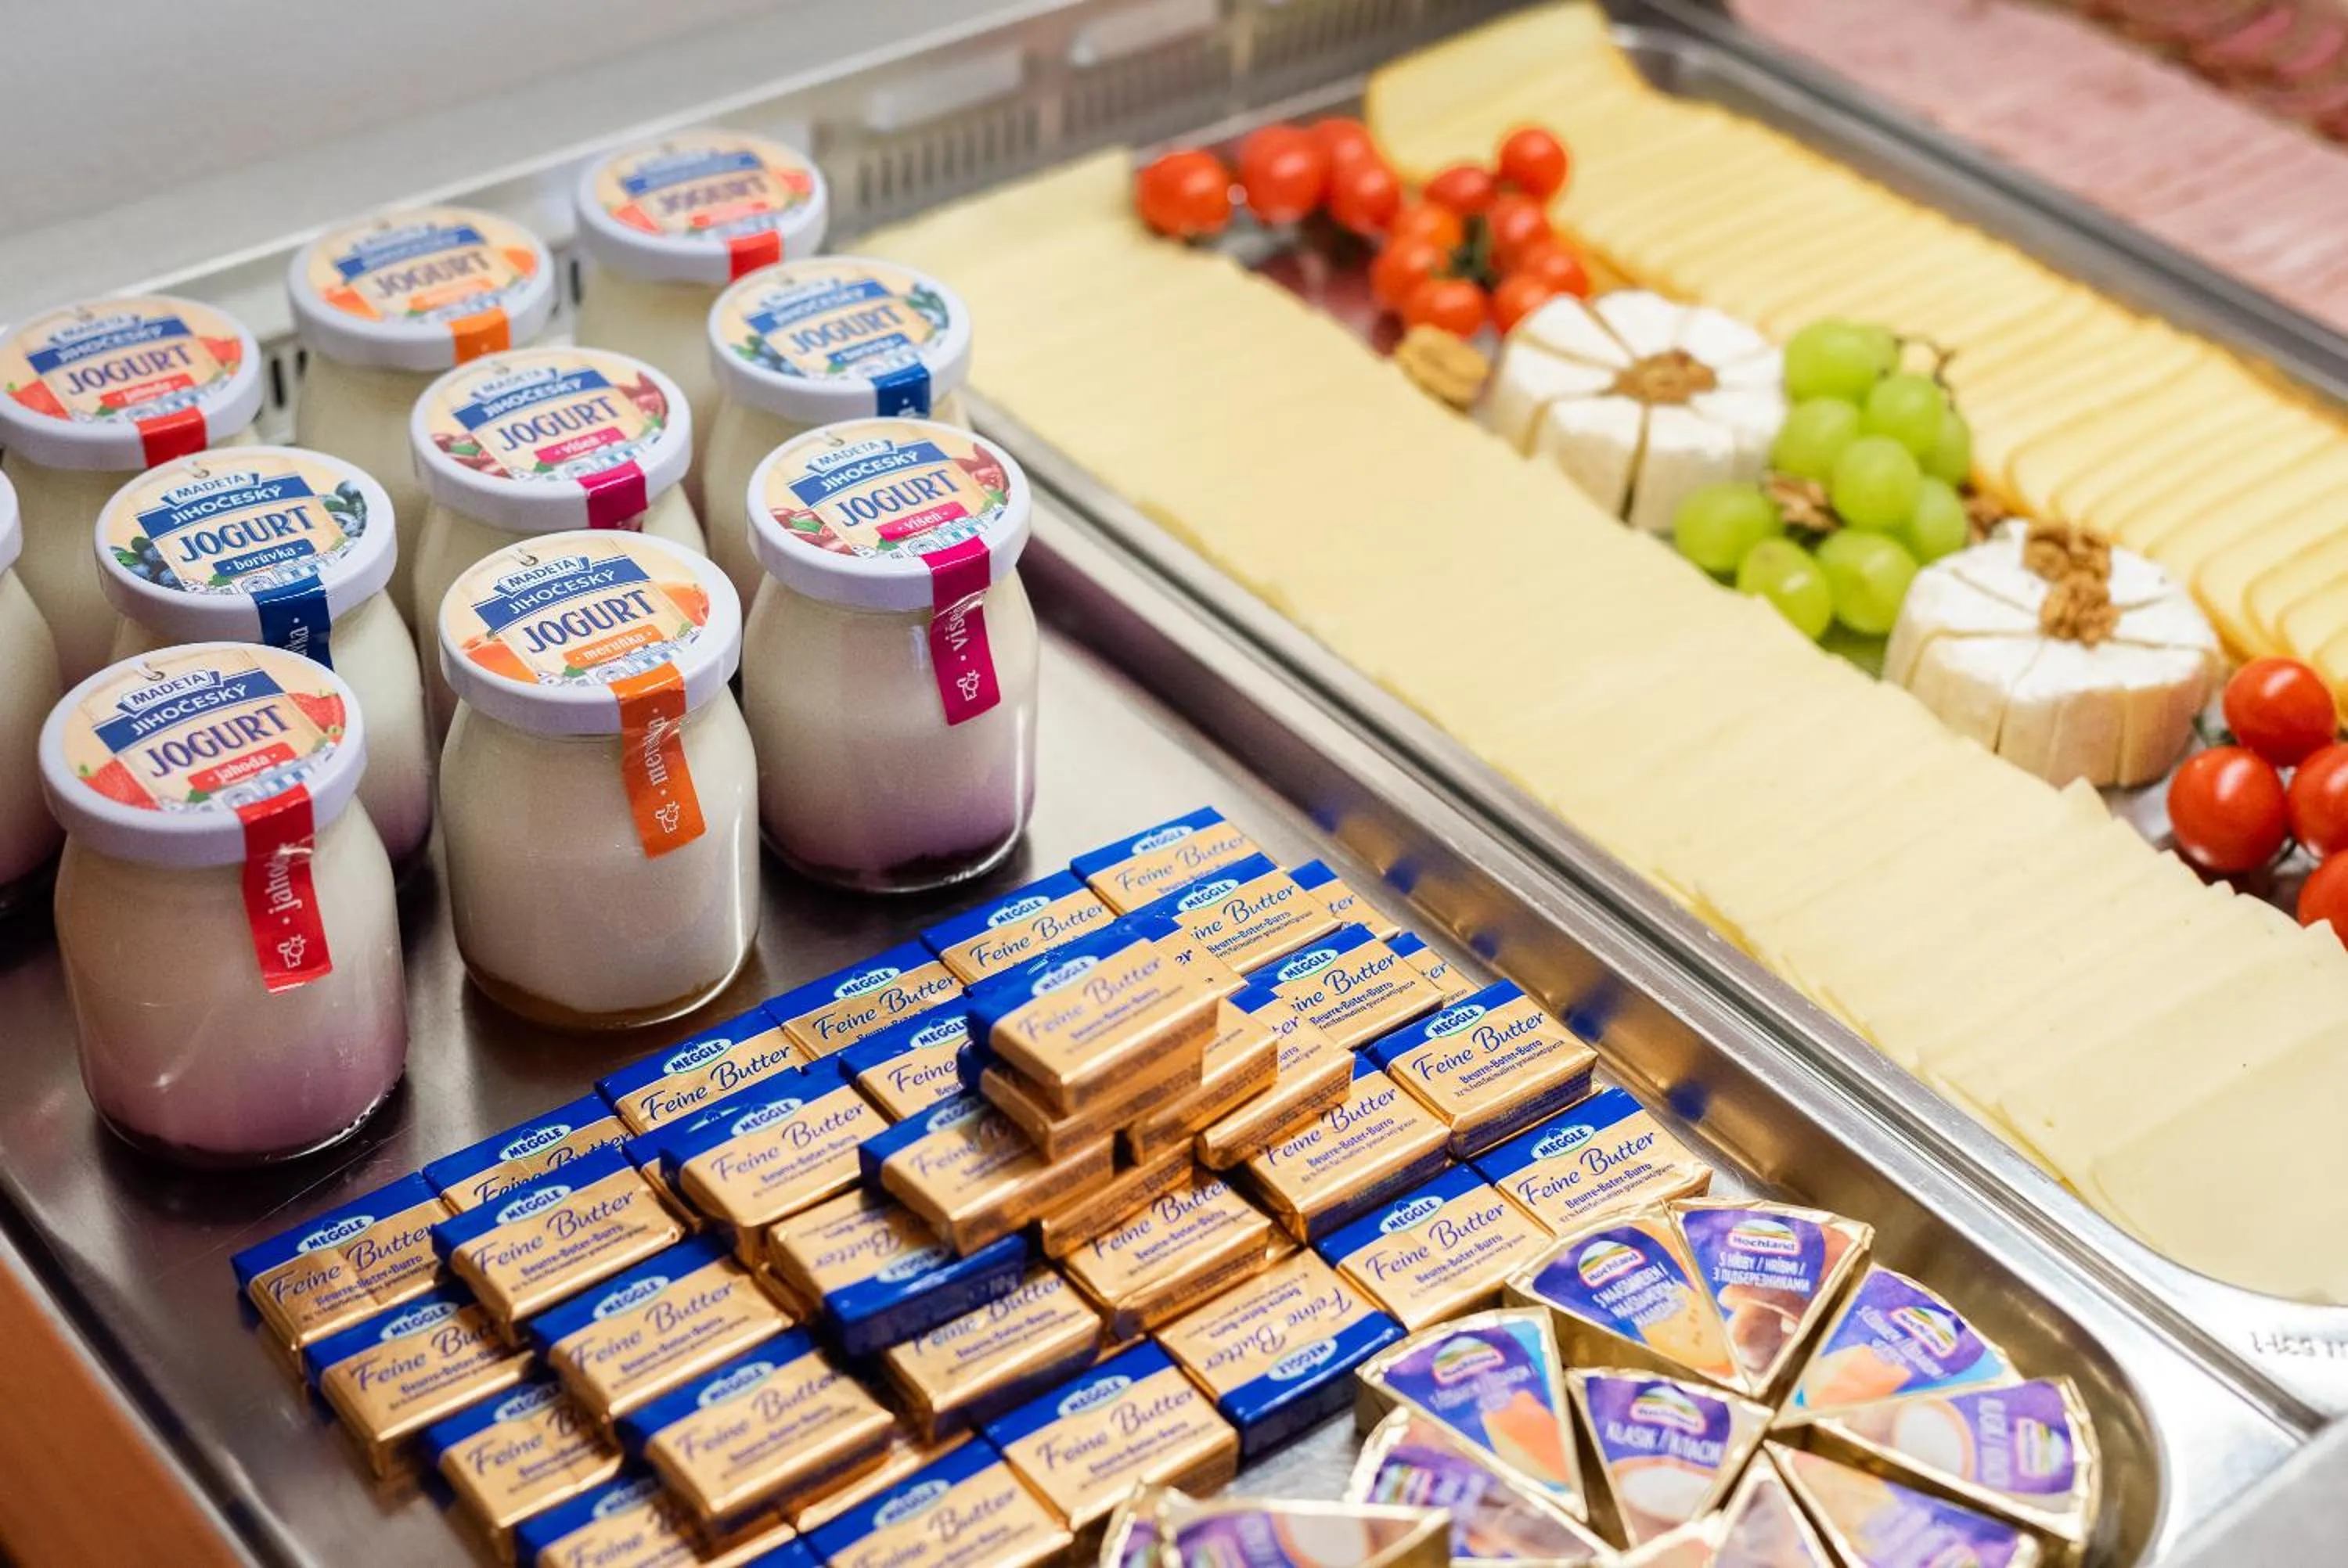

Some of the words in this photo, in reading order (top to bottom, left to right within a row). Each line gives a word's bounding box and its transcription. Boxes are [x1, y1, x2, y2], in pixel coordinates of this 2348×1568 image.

[789, 304, 903, 354] JOGURT
[67, 343, 193, 396] JOGURT
[497, 397, 618, 451] JOGURT
[817, 441, 880, 466] MADETA
[822, 451, 920, 491] JIHOČESKÝ
[175, 473, 247, 498] MADETA
[835, 470, 960, 527] JOGURT
[178, 505, 315, 563] JOGURT
[507, 559, 574, 587] MADETA
[510, 568, 615, 614] JIHOČESKÝ
[522, 590, 657, 654] JOGURT
[132, 674, 207, 705] MADETA
[133, 683, 247, 735] JIHOČESKÝ
[146, 705, 291, 778] JOGURT
[214, 755, 269, 782] jahoda
[1140, 828, 1187, 851] MEGGLE
[1115, 865, 1173, 891] Feine
[1176, 836, 1245, 869] Butter
[996, 899, 1043, 924] MEGGLE
[1186, 881, 1233, 908] MEGGLE
[1190, 919, 1223, 941] ine
[1223, 884, 1295, 925] Butter
[970, 937, 1030, 967] Feine
[1032, 903, 1104, 940] Butter
[842, 970, 892, 995] MEGGLE
[1284, 951, 1331, 979] MEGGLE
[1291, 991, 1325, 1012] ine
[1323, 955, 1395, 996] Butter
[812, 1008, 877, 1040] Feine
[879, 976, 957, 1014] Butter
[1018, 1007, 1084, 1041] Feine
[1083, 957, 1161, 1004] Butter
[1431, 1009, 1479, 1037] MEGGLE
[672, 1042, 723, 1071] MEGGLE
[1412, 1048, 1474, 1081] Feine
[1472, 1012, 1544, 1053] Butter
[641, 1088, 708, 1120] Feine
[710, 1046, 790, 1091] Butter
[888, 1060, 956, 1092] Feine
[740, 1101, 794, 1131] MEGGLE
[1264, 1130, 1322, 1166] Feine
[1322, 1088, 1396, 1133] Butter
[509, 1129, 563, 1158] MEGGLE
[711, 1145, 780, 1181] Feine
[783, 1103, 864, 1149] Butter
[1539, 1127, 1588, 1156] MEGGLE
[1518, 1171, 1579, 1205] Feine
[1579, 1131, 1655, 1176] Butter
[508, 1189, 562, 1219] MEGGLE
[1151, 1180, 1231, 1224] Butter
[1387, 1199, 1437, 1230] MEGGLE
[307, 1219, 366, 1249] MEGGLE
[471, 1234, 544, 1276] Feine
[547, 1192, 632, 1240] Butter
[1365, 1246, 1430, 1282] Feine
[1428, 1204, 1504, 1250] Butter
[1733, 1235, 1796, 1251] Hochland
[267, 1266, 340, 1304] Feine
[345, 1225, 432, 1271] Butter
[391, 1307, 451, 1336] MEGGLE
[571, 1331, 642, 1375] Feine
[645, 1283, 733, 1332] Butter
[1287, 1288, 1352, 1324] Feine
[1205, 1324, 1287, 1371] Butter
[351, 1353, 427, 1391] Feine
[1036, 1432, 1110, 1469] Feine
[1110, 1388, 1194, 1435] Butter
